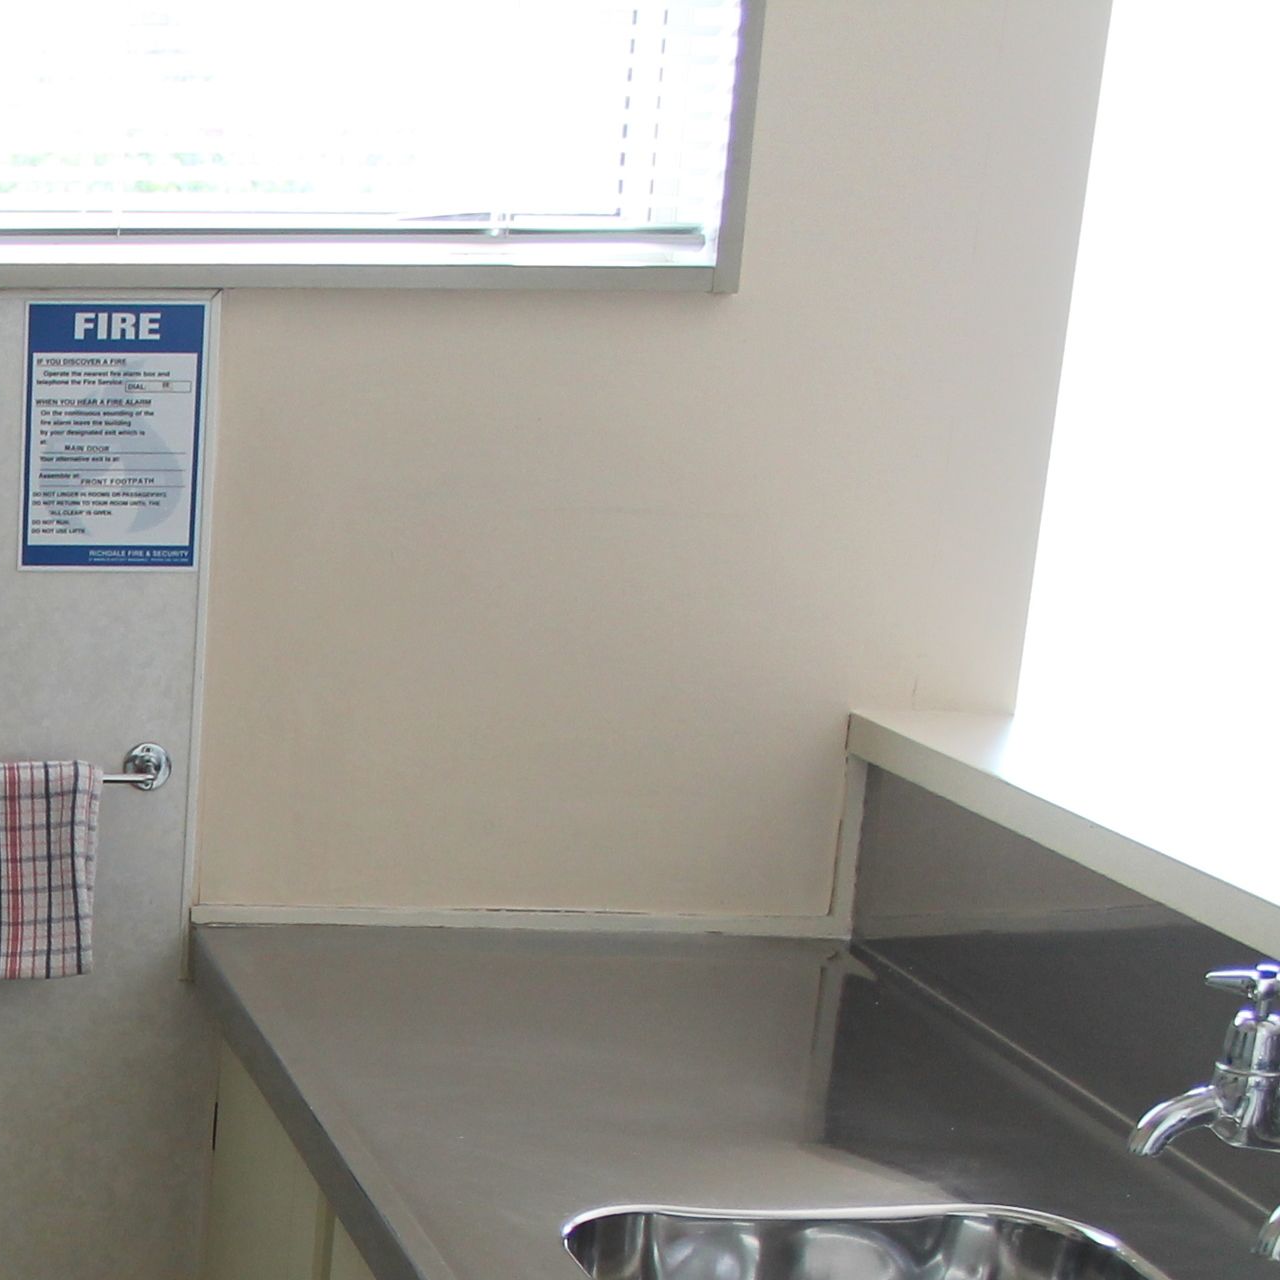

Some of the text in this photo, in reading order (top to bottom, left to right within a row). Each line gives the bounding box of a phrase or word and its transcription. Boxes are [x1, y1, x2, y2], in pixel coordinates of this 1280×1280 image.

[74, 312, 161, 341] FIRE
[40, 419, 131, 427] fire alarm leave the building
[40, 429, 145, 437] by your designated exit which is
[80, 478, 155, 486] FRONT FOOTPATH
[127, 550, 145, 558] FIRE
[146, 550, 151, 558] &
[152, 550, 190, 558] SECURITY
